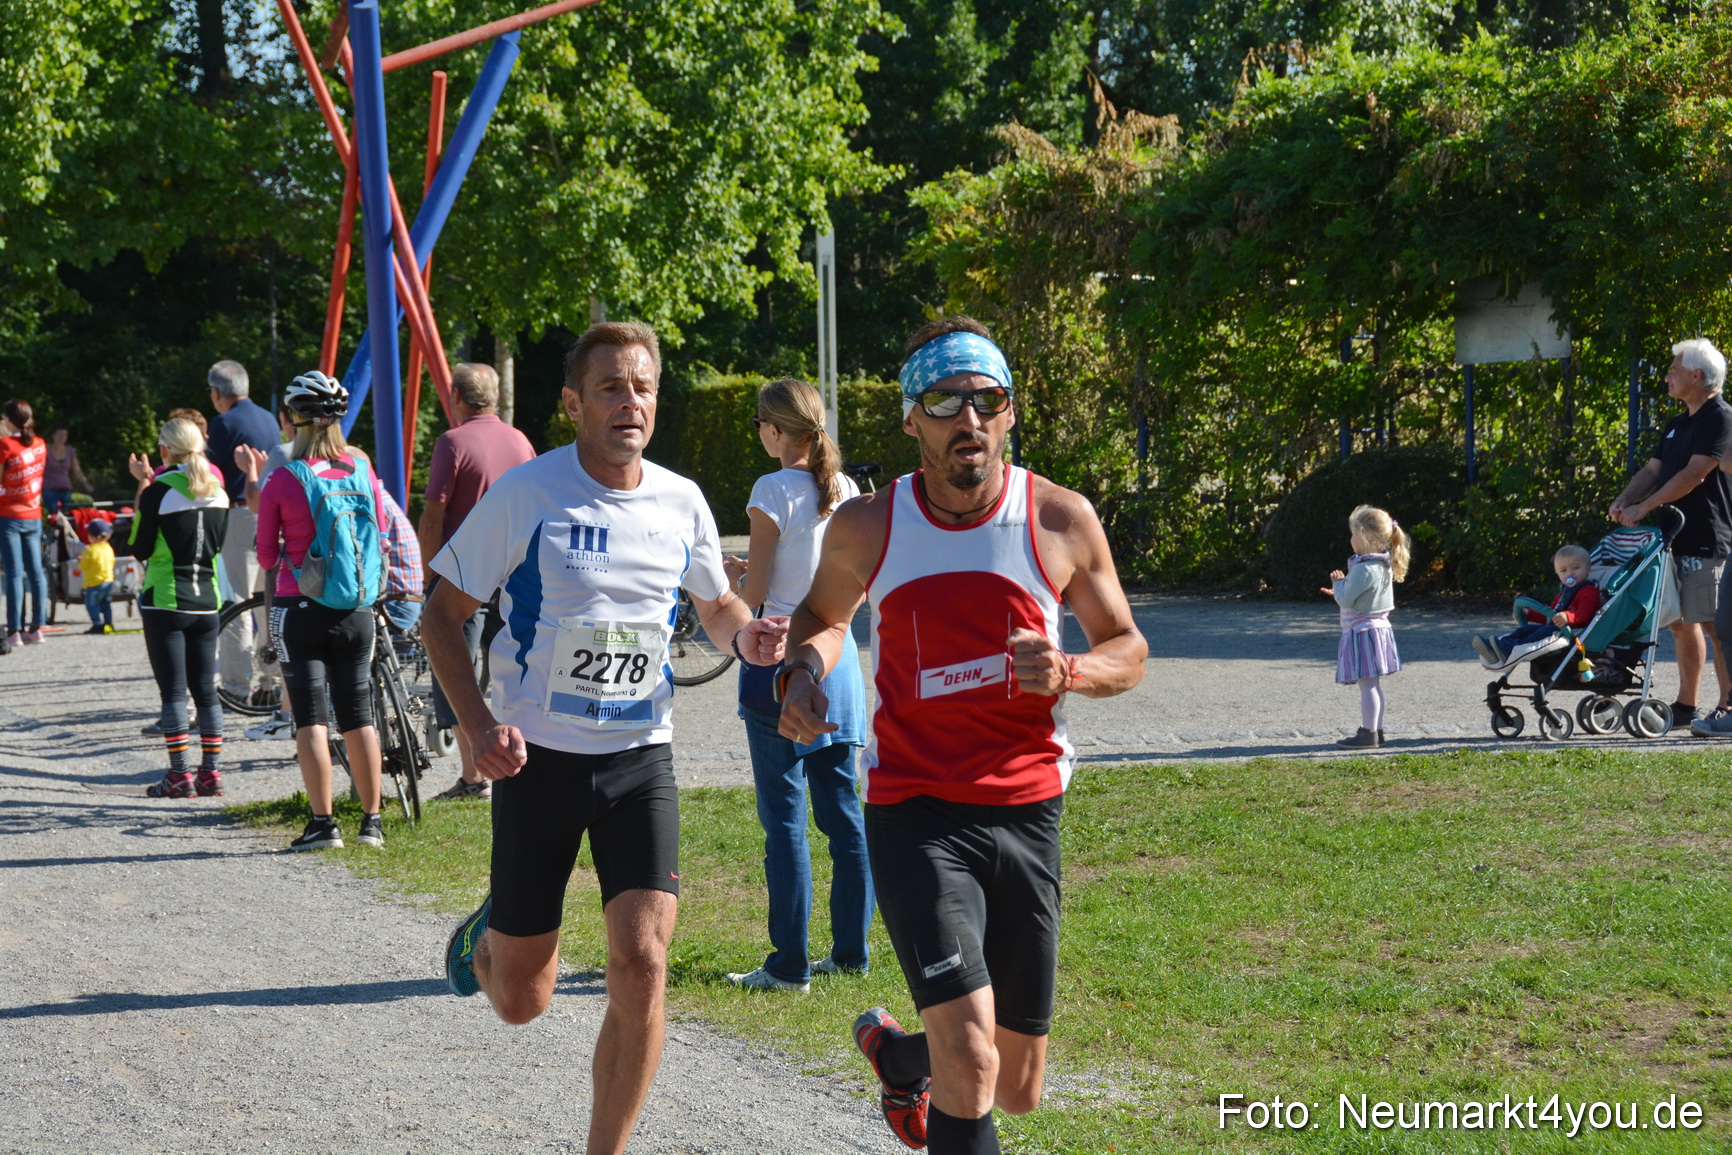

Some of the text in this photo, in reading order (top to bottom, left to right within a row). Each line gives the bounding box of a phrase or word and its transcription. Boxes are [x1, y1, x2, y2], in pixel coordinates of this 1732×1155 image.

[566, 550, 610, 563] athlon
[594, 630, 638, 643] BOCK
[570, 649, 649, 684] 2278
[943, 667, 982, 686] DEHN
[575, 684, 628, 697] PARTL Neumarkt
[585, 702, 621, 718] Armin
